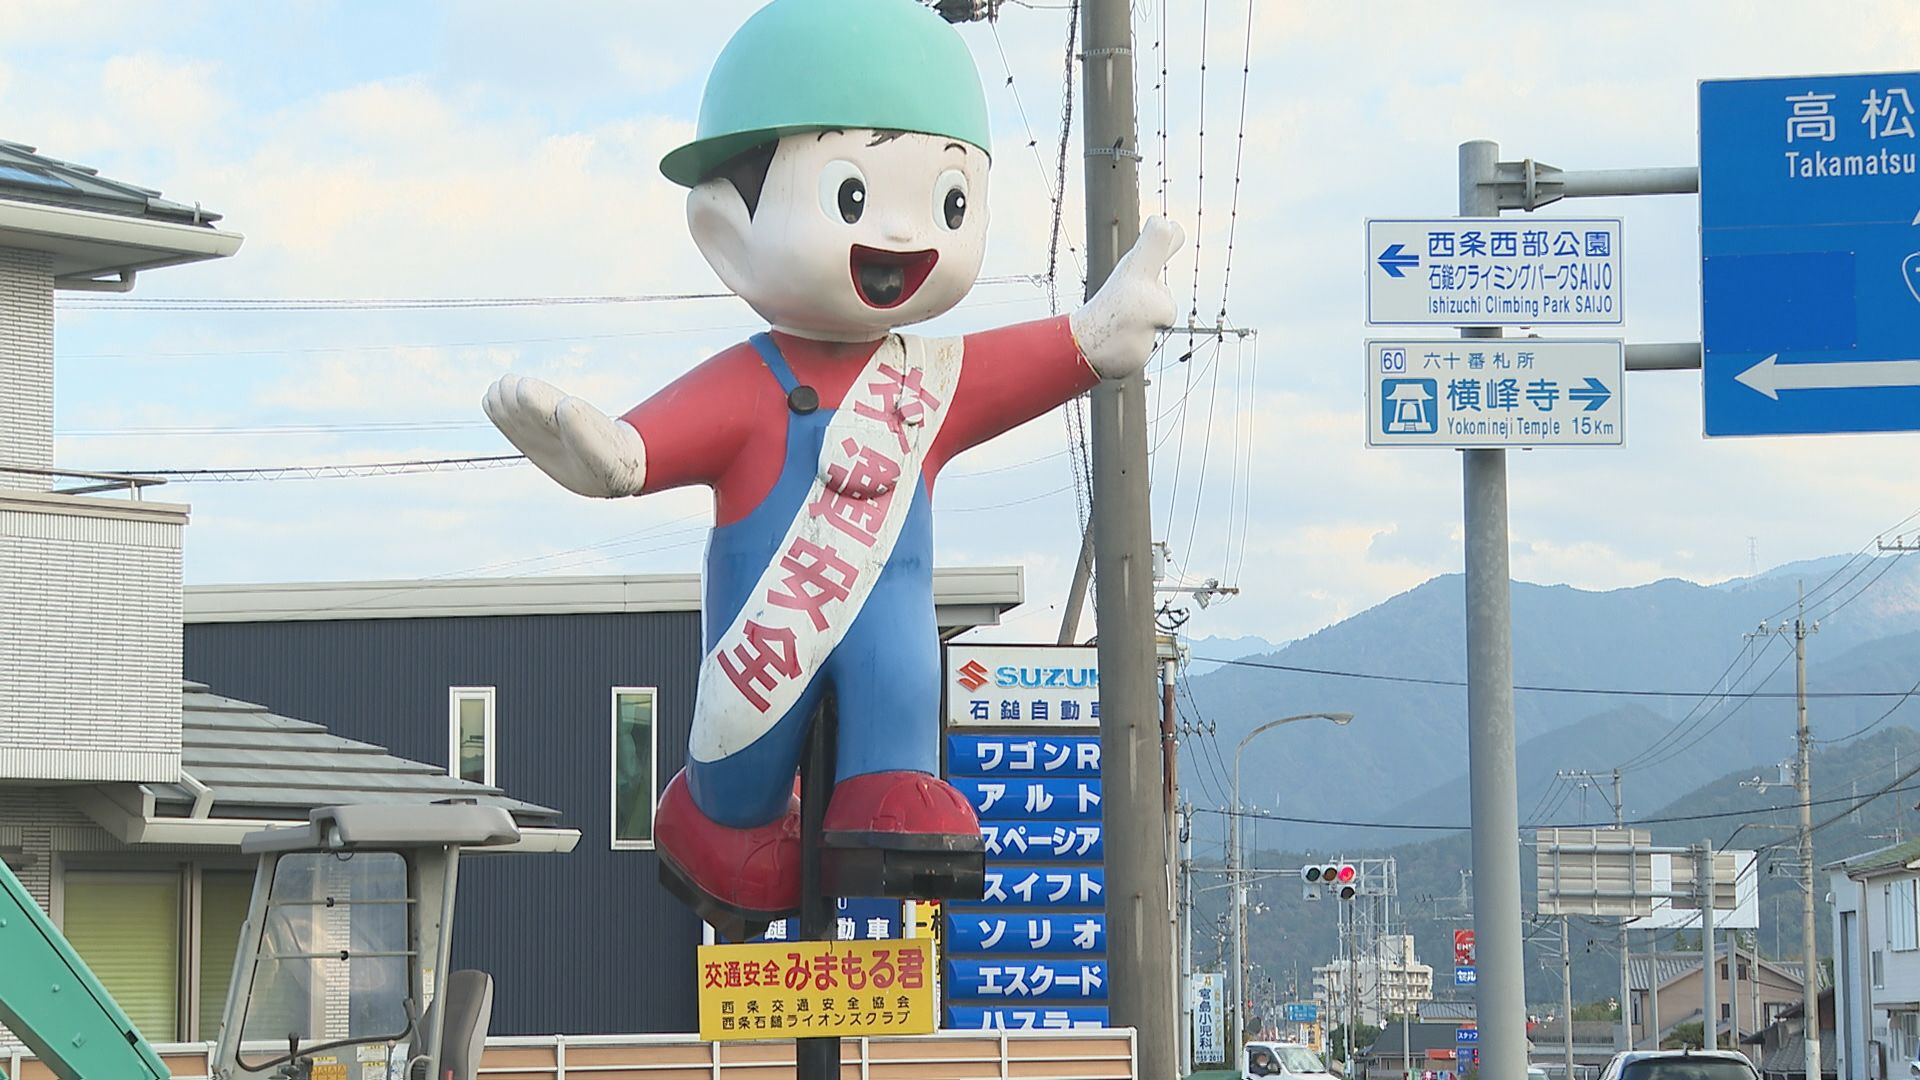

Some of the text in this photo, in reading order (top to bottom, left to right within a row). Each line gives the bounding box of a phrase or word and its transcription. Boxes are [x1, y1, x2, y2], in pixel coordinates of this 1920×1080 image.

[1785, 88, 1916, 143] 高松
[1785, 148, 1916, 178] Takamatsu
[1428, 230, 1611, 257] 西条西部公園
[1428, 296, 1612, 317] Ishizuchi Climbing Park SAIJO
[1383, 352, 1404, 370] 60
[1423, 352, 1535, 370] 六十番札所
[1447, 378, 1560, 412] 横峰寺
[1447, 417, 1513, 439] Yokomineji
[1517, 417, 1560, 438] Temple
[717, 363, 940, 714] 交通安全
[977, 741, 1101, 771] ワゴンR
[978, 784, 1101, 813] アルト
[980, 826, 1100, 856] スペーシア
[981, 872, 1102, 902] スイフト
[978, 920, 1101, 949] ソリオ
[978, 965, 1102, 997] エスクード
[722, 996, 910, 1014] 西条交通安全協会
[722, 1011, 910, 1030] 西条石鎚ライオンズクラブ
